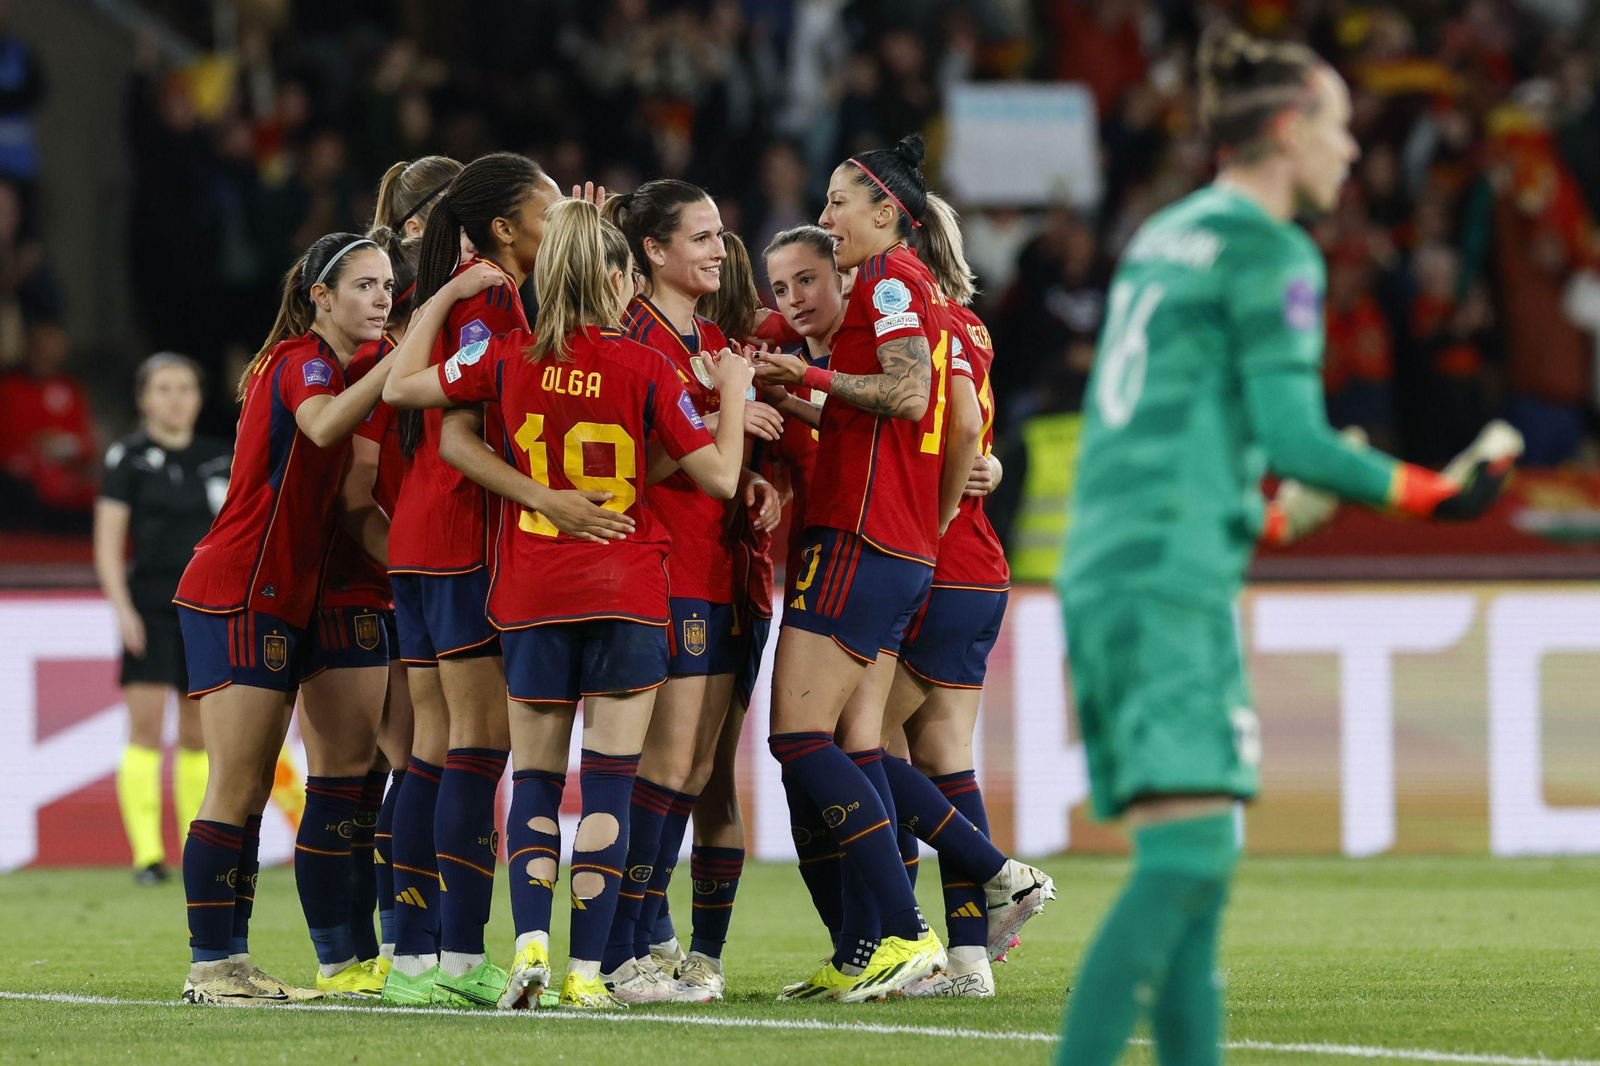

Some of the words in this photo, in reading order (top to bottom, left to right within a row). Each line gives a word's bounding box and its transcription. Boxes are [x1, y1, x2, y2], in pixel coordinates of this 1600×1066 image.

[876, 317, 918, 330] FOUNDATION
[541, 366, 602, 398] OLGA
[847, 801, 860, 812] 09
[215, 874, 226, 882] 19
